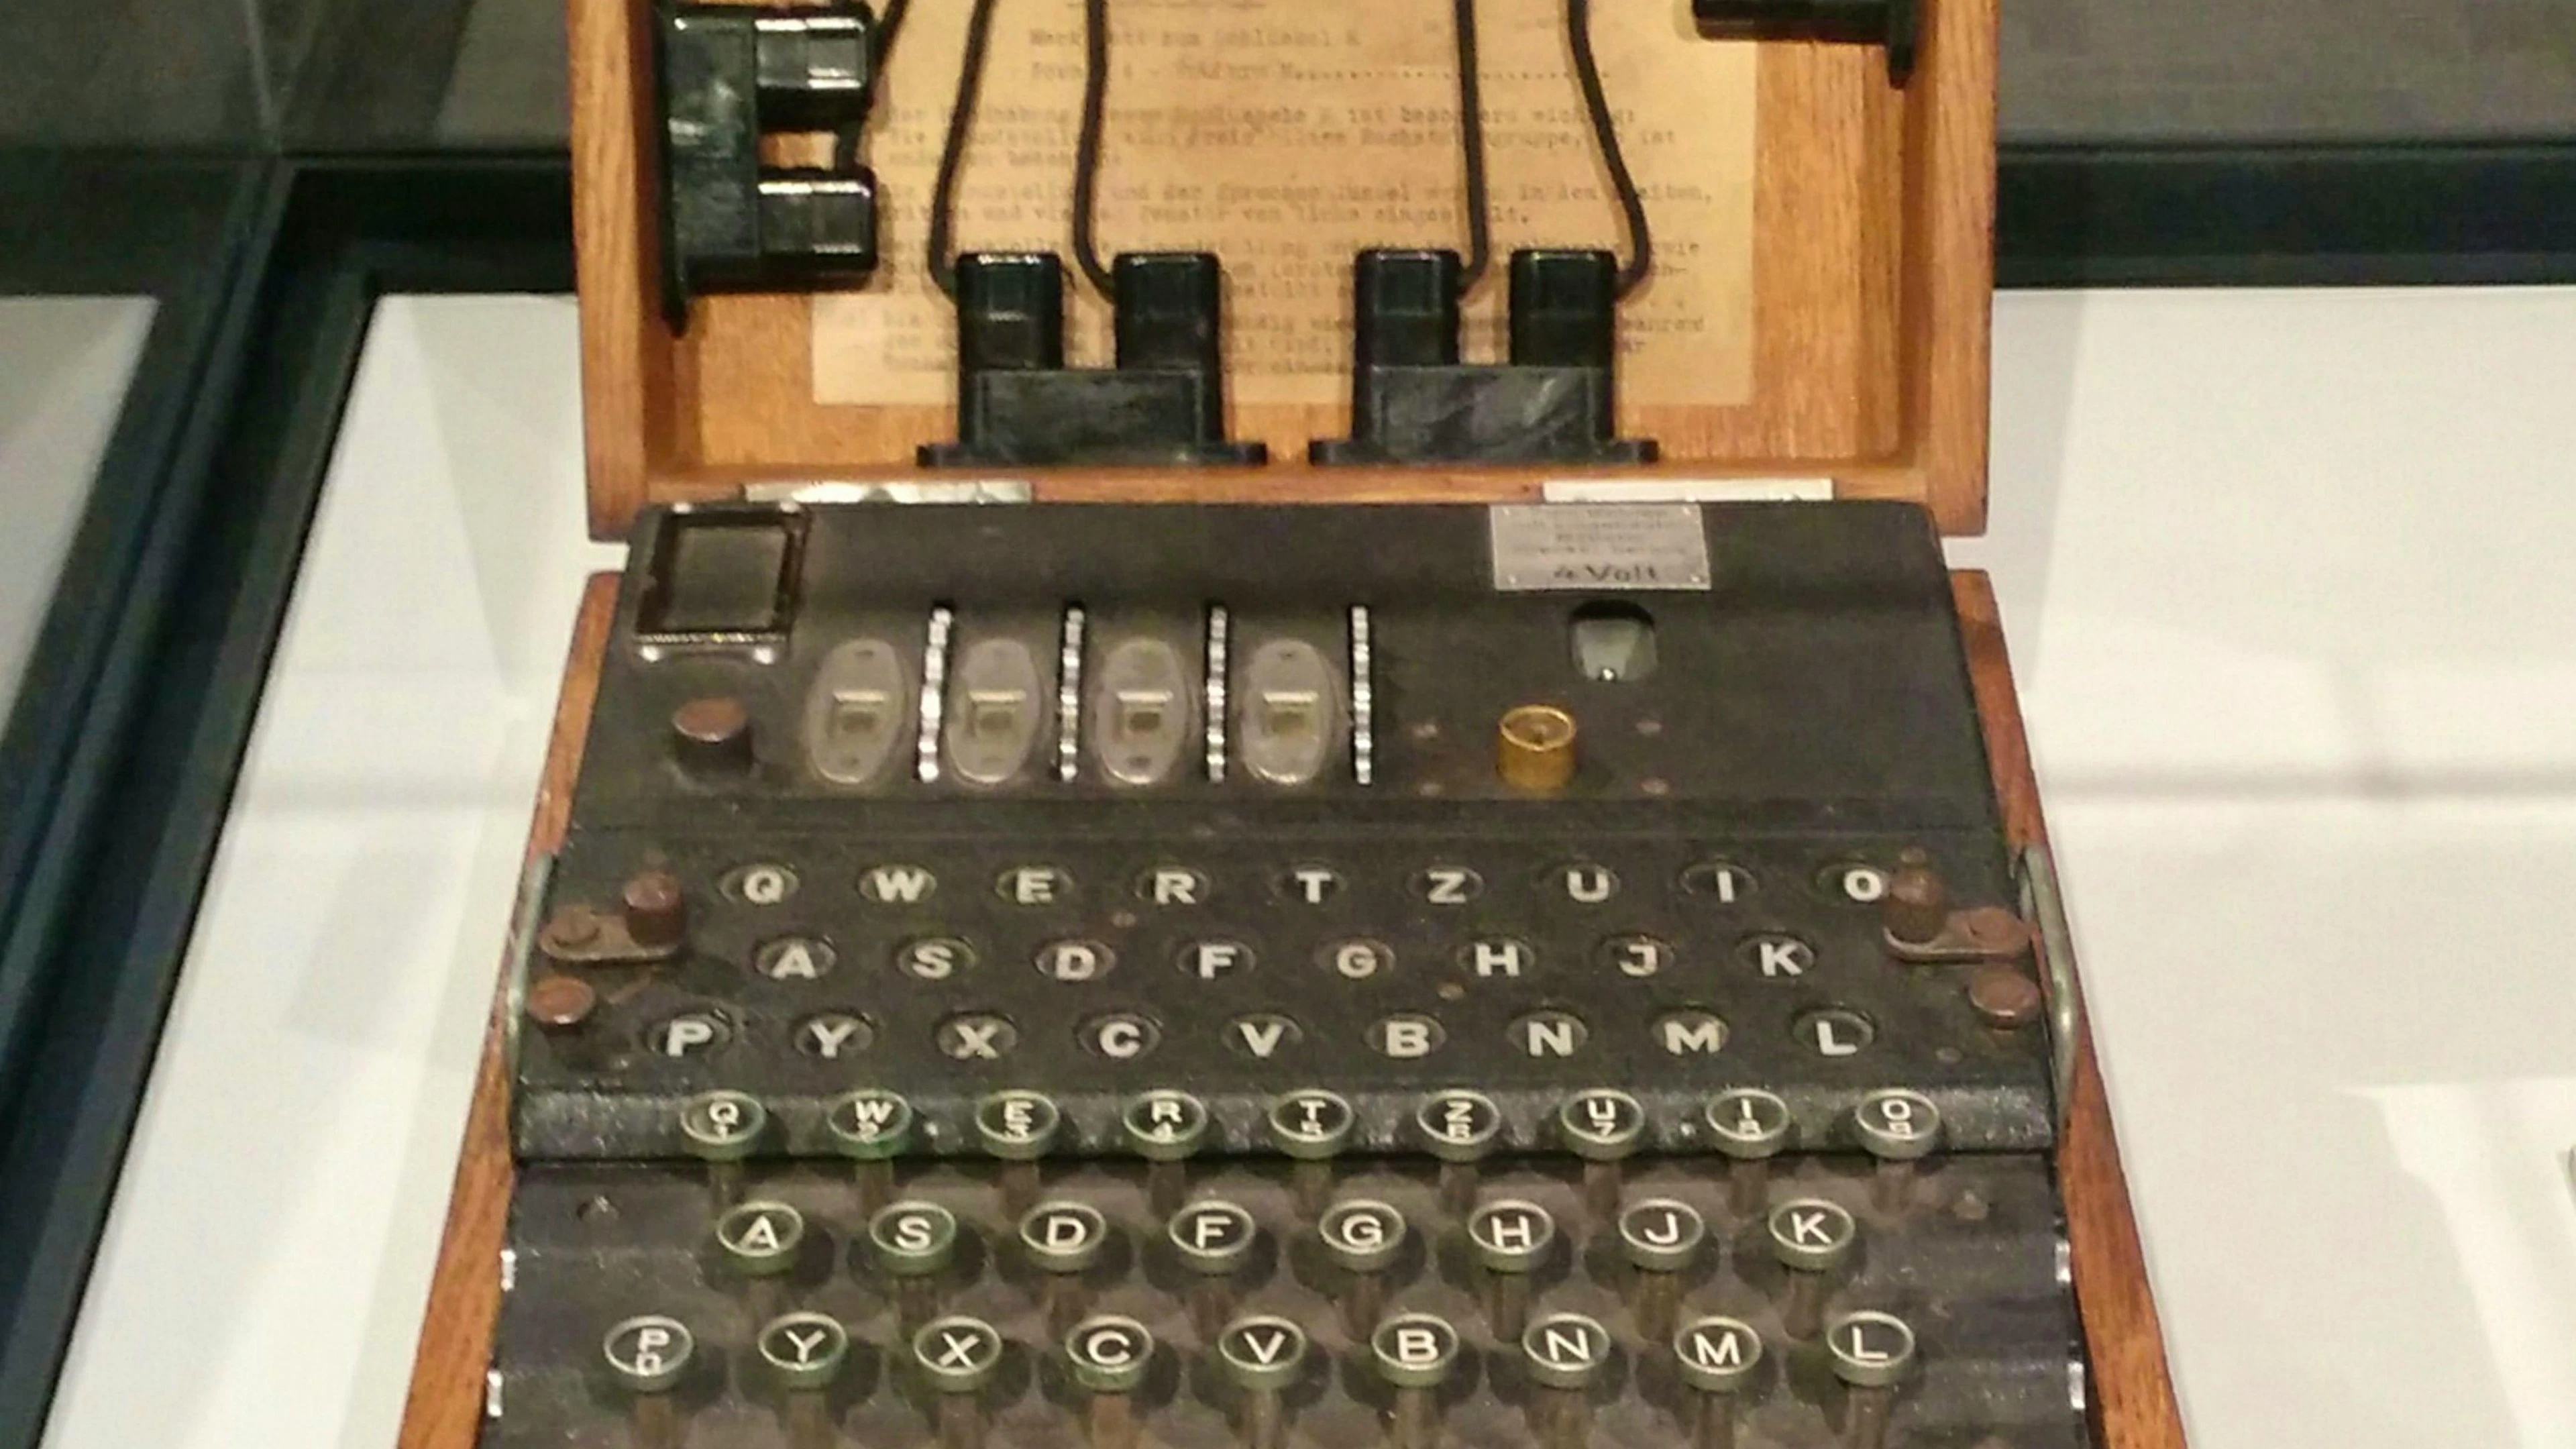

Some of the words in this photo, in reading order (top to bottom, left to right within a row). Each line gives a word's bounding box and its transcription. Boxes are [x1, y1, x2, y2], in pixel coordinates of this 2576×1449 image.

[1585, 564, 1658, 582] Volt
[745, 871, 783, 902] Q
[875, 870, 924, 900] W
[1018, 870, 1053, 902] E
[1156, 872, 1195, 904] R
[1297, 871, 1331, 902] T
[1430, 871, 1465, 902] Z
[1568, 871, 1609, 901] U
[1718, 871, 1733, 902] I
[1845, 870, 1880, 900] O
[773, 944, 815, 977] A
[913, 945, 951, 977] S
[1057, 947, 1094, 979] D
[1200, 945, 1236, 977] F
[1338, 945, 1376, 977] G
[1477, 945, 1519, 975] H
[1621, 945, 1656, 975] J
[1761, 943, 1802, 975] K
[668, 1021, 712, 1056] P
[810, 1022, 855, 1057] Y
[957, 1024, 997, 1057] X
[1101, 1022, 1139, 1057] C
[1240, 1023, 1281, 1056] V
[1387, 1022, 1429, 1056] B
[1529, 1022, 1572, 1055] N
[1665, 1020, 1720, 1054] M
[1817, 1022, 1857, 1055] L
[708, 1101, 739, 1125] Q
[855, 1100, 893, 1124] W
[1004, 1100, 1033, 1124] E
[1151, 1101, 1183, 1123] R
[1297, 1100, 1326, 1121] T
[1444, 1101, 1473, 1123] Z
[1587, 1099, 1616, 1120] U
[739, 1216, 781, 1251] A
[896, 1217, 930, 1250] S
[1044, 1217, 1087, 1246] D
[1195, 1216, 1231, 1249] F
[1341, 1215, 1385, 1246] G
[1490, 1216, 1532, 1248] H
[1646, 1214, 1678, 1244] J
[1792, 1213, 1831, 1244] K
[637, 1329, 669, 1354] P
[786, 1331, 826, 1363] Y
[938, 1333, 982, 1368] X
[1088, 1332, 1130, 1365] C
[1245, 1332, 1284, 1364] V
[1395, 1330, 1438, 1363] B
[1546, 1329, 1590, 1361] N
[1693, 1332, 1740, 1365] M
[1849, 1327, 1889, 1361] L
